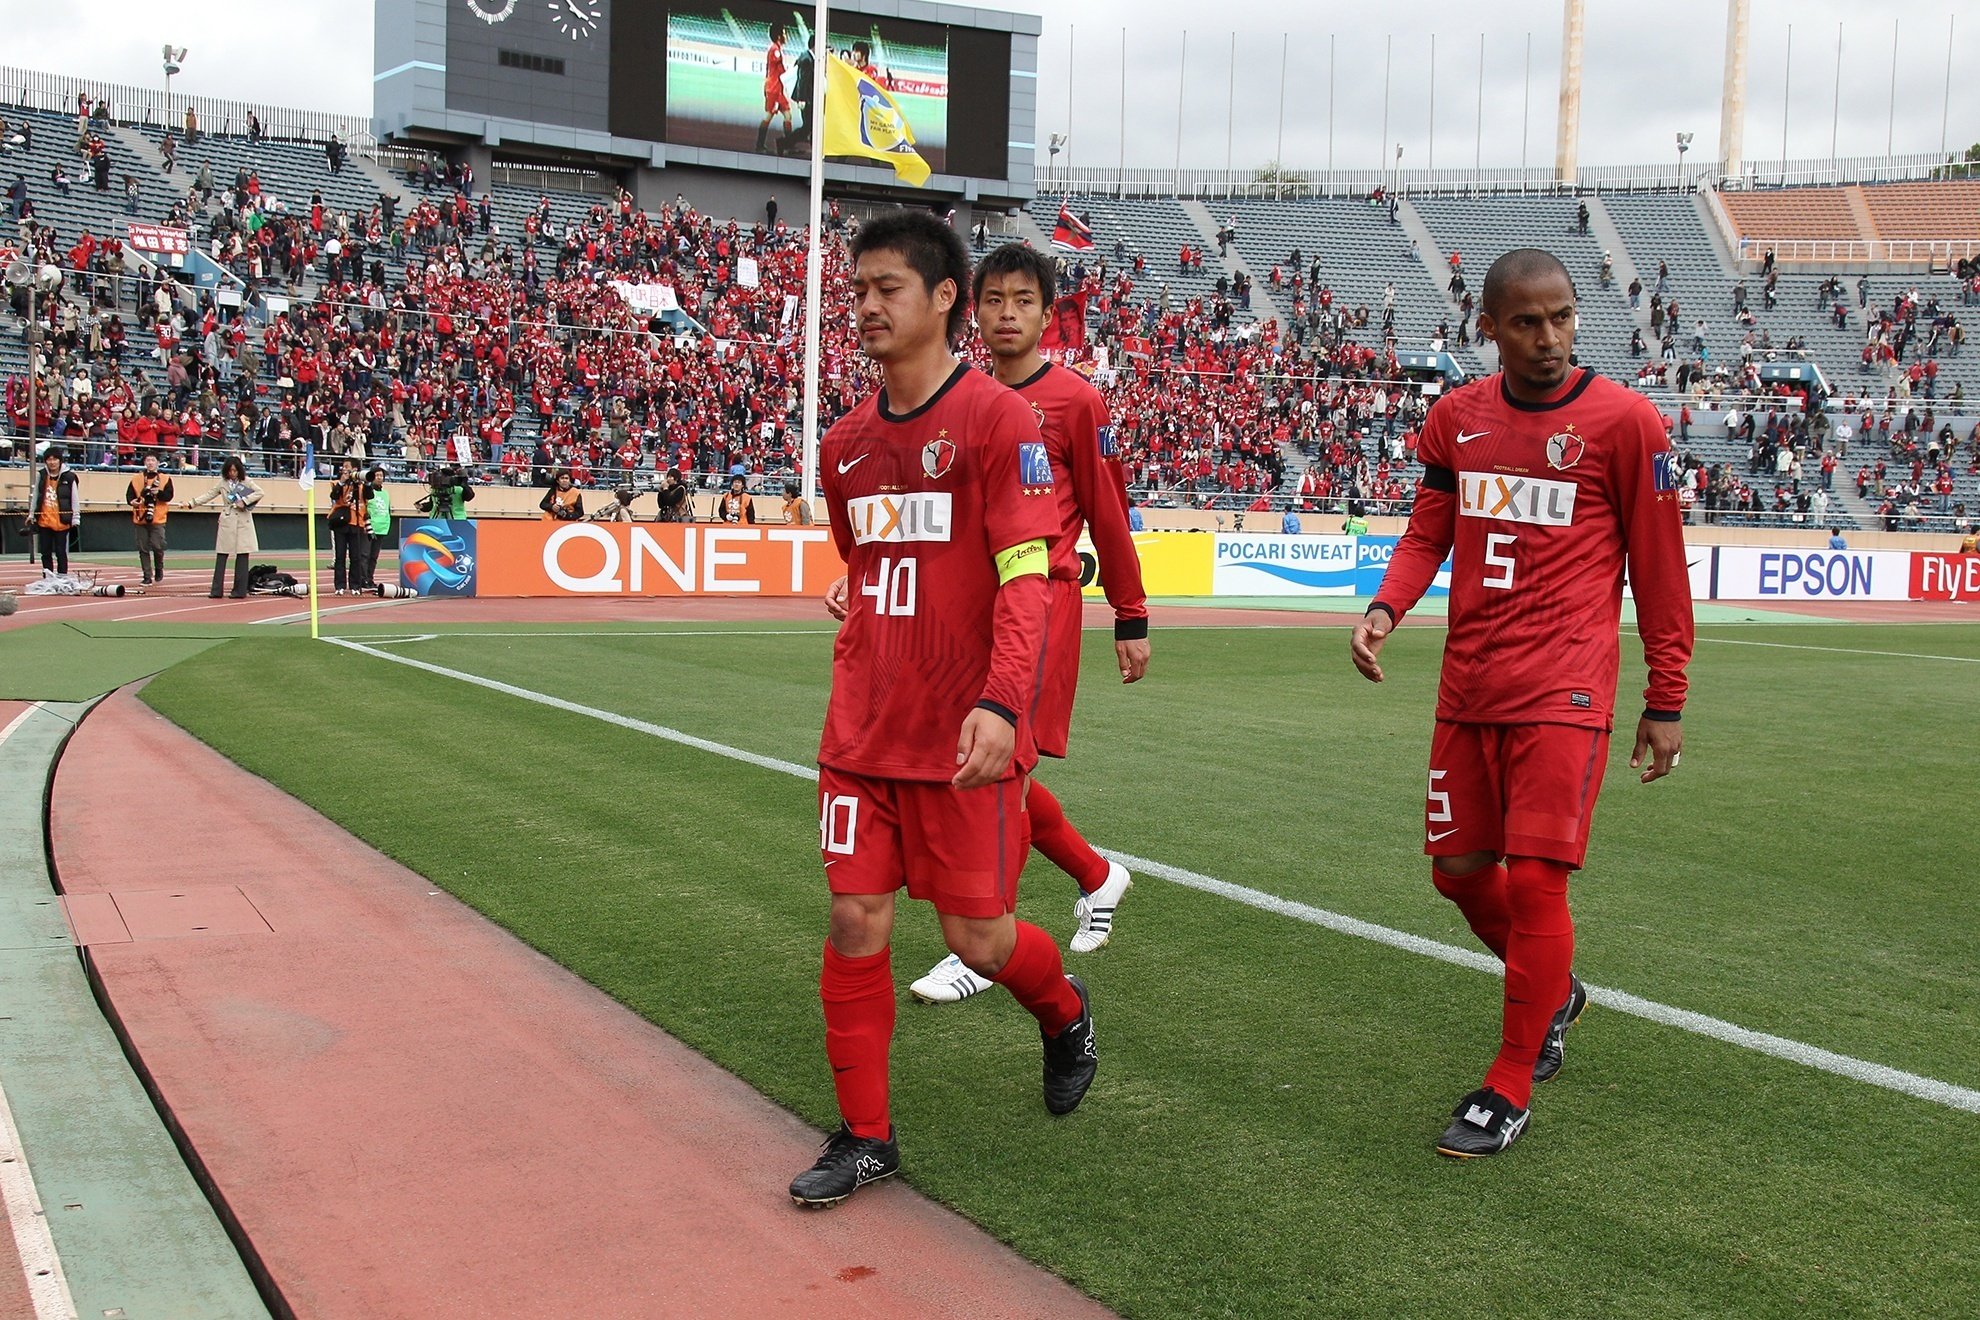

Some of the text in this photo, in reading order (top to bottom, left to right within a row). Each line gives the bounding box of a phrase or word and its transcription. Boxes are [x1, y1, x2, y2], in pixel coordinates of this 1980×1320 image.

[850, 496, 943, 540] LIXIL
[1461, 475, 1566, 520] LIXIL
[542, 522, 828, 593] QNET
[1218, 542, 1352, 560] POCARI SWEAT
[1358, 544, 1393, 562] POC
[1482, 532, 1518, 590] 5
[861, 557, 917, 616] 40
[1758, 553, 1873, 596] EPSON
[1428, 769, 1453, 822] 5
